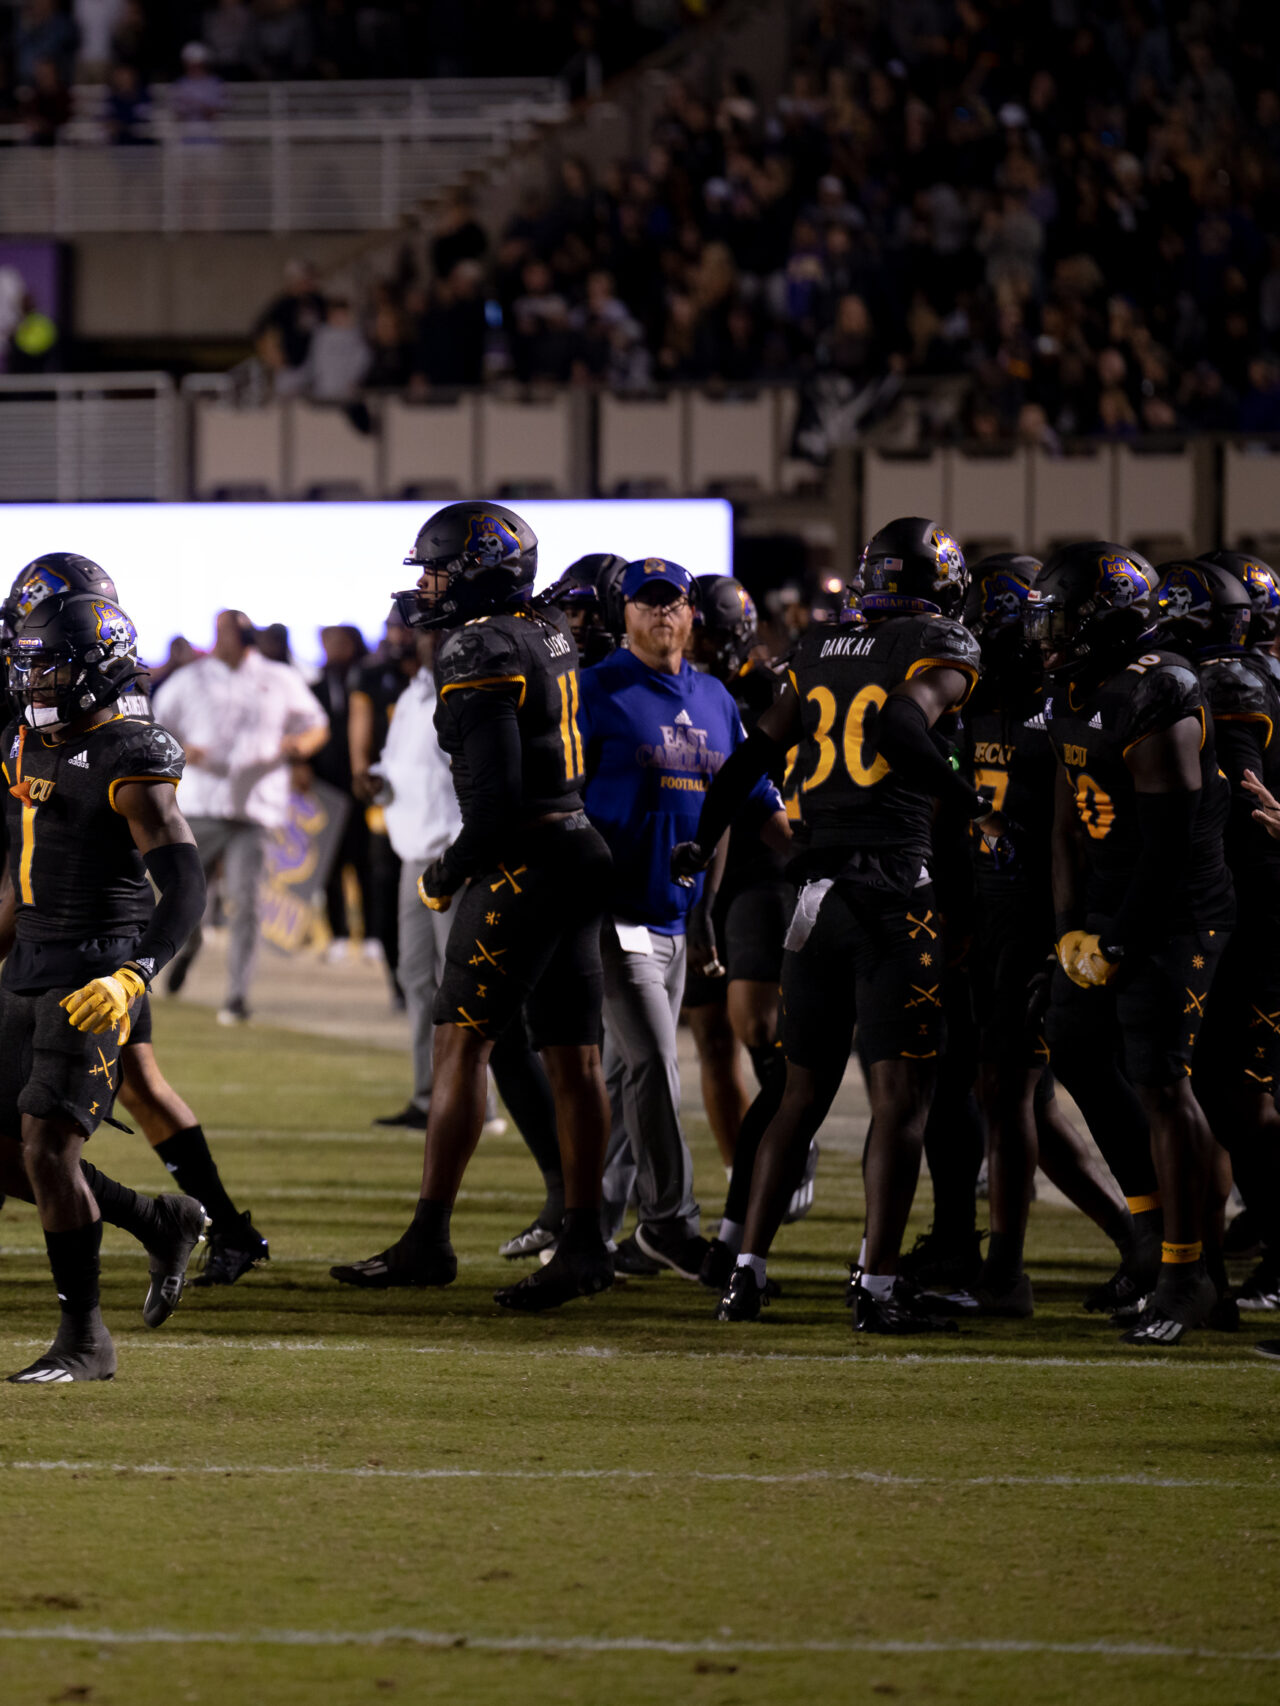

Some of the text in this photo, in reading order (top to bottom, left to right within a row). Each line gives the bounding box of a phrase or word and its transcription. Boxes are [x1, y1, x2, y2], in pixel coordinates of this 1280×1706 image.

[1107, 562, 1126, 574] ECU
[556, 668, 585, 781] 11
[659, 726, 708, 752] EAST
[805, 682, 892, 788] 30
[1063, 743, 1089, 768] ECU
[19, 803, 40, 907] 1
